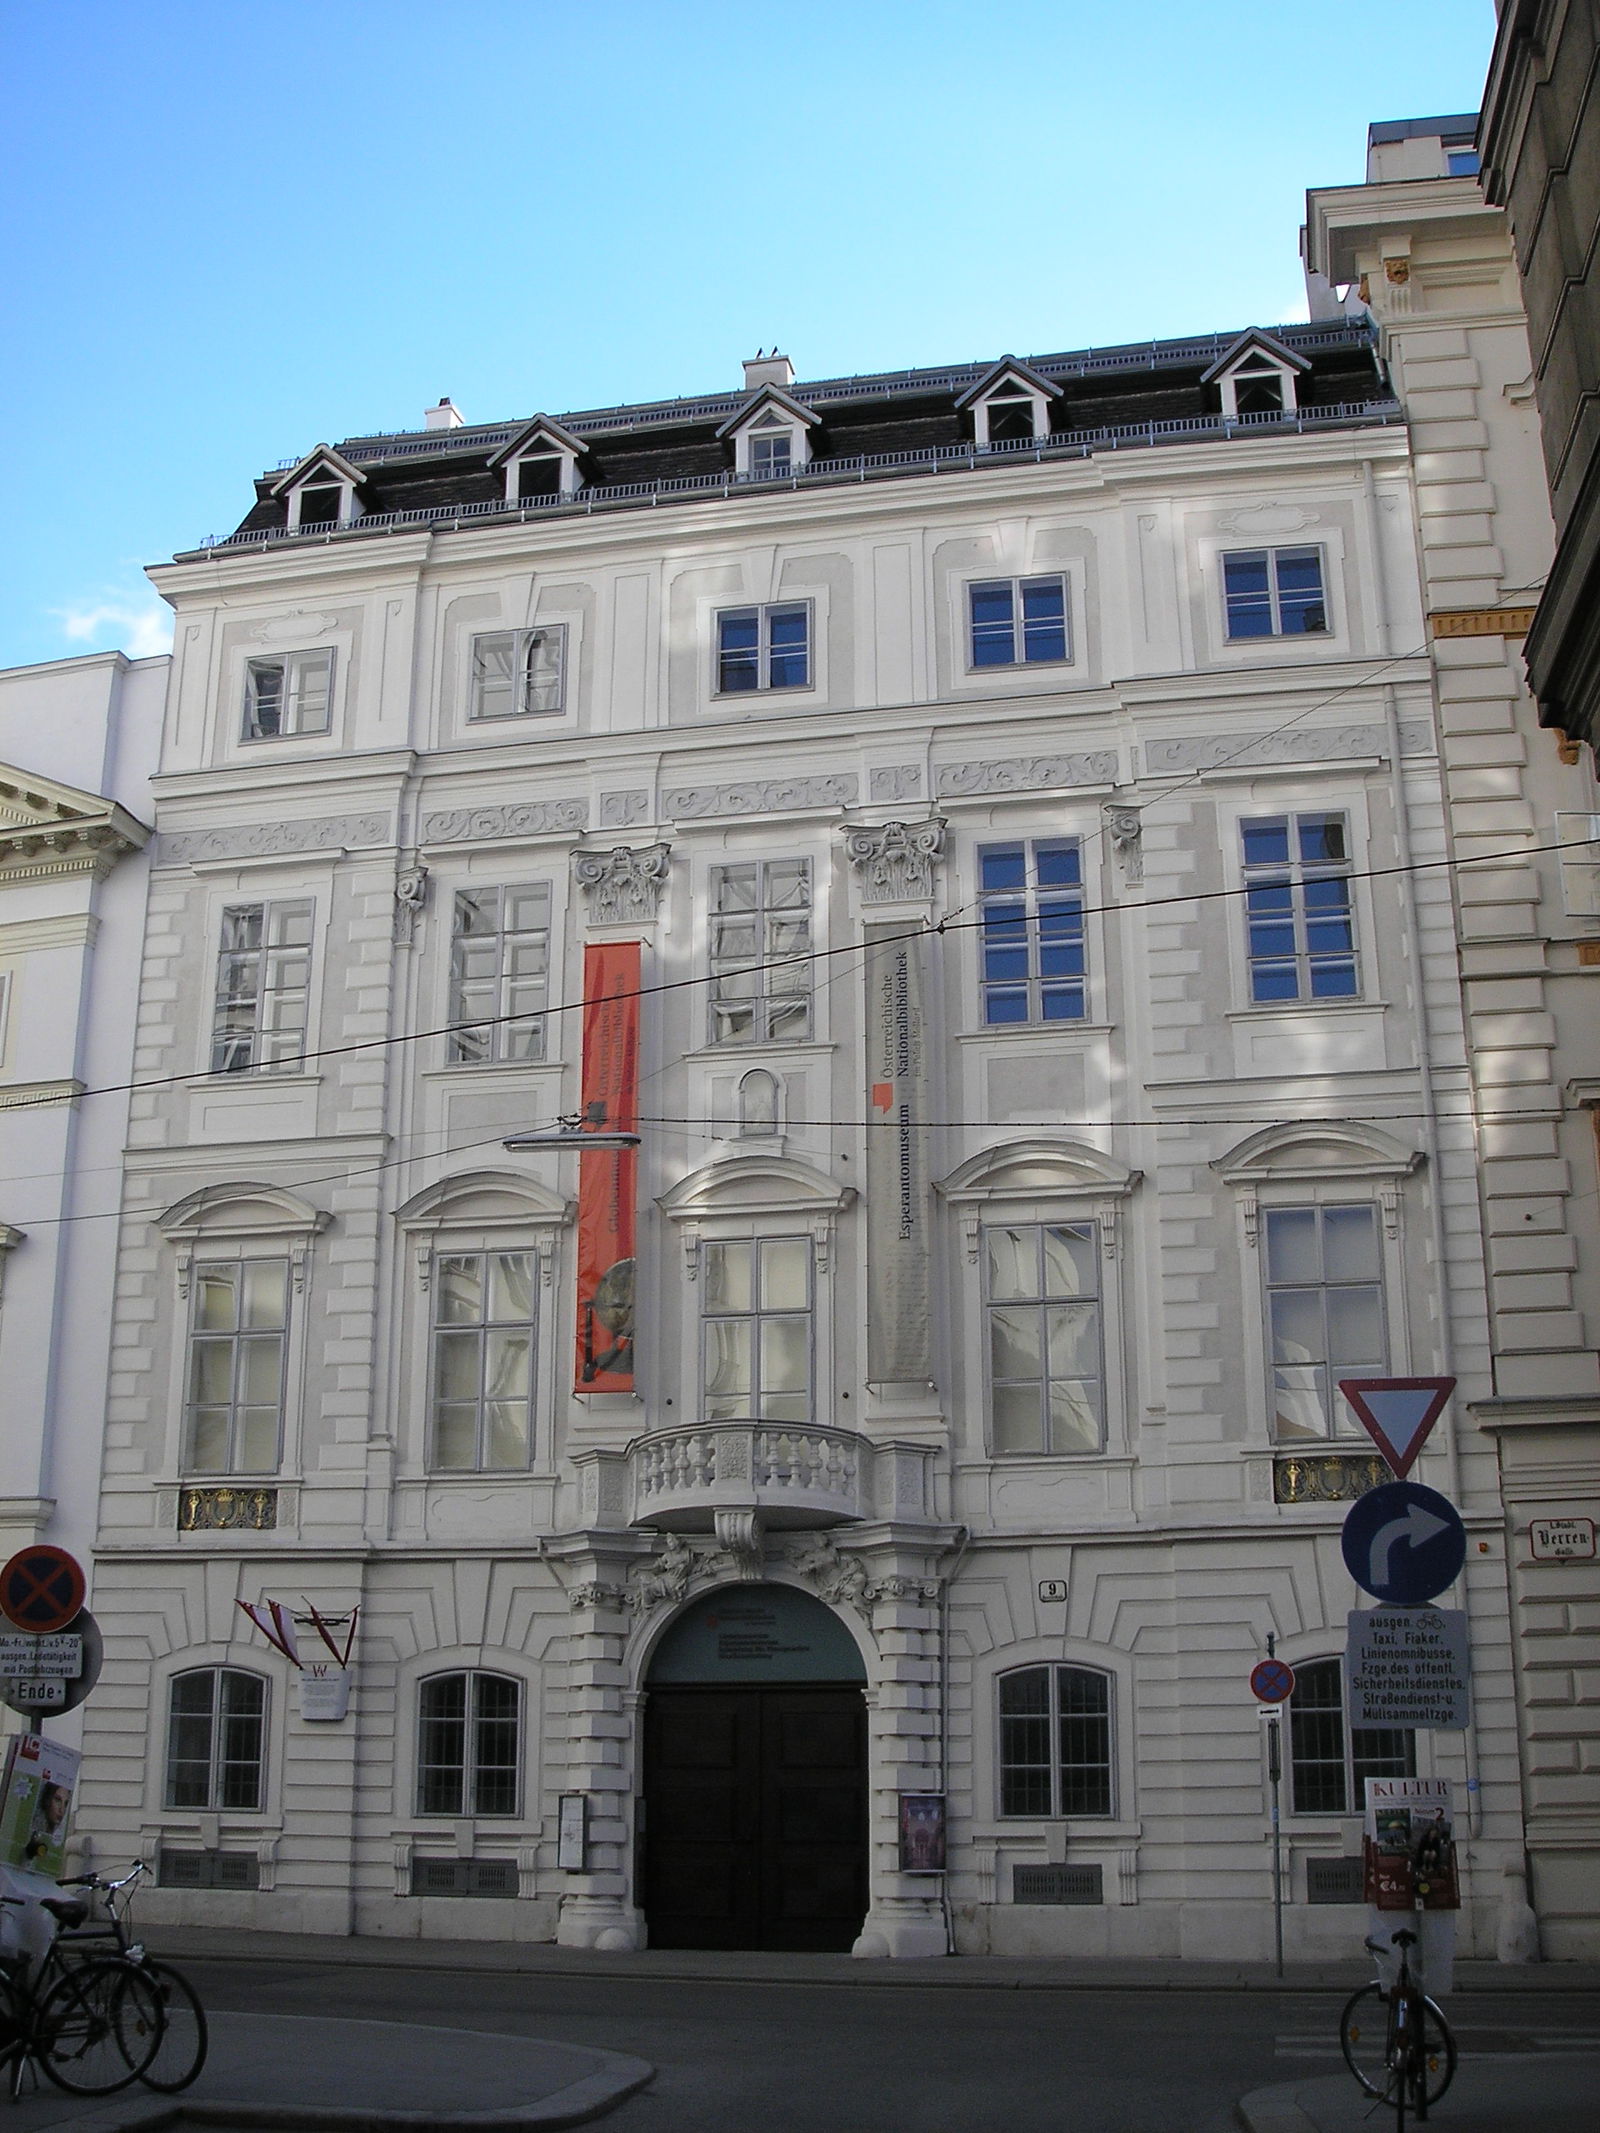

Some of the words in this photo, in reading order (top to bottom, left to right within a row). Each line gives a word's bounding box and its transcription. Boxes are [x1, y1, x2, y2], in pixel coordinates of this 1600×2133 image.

[880, 975, 894, 1079] Österreichische
[895, 951, 910, 1078] Nationalbibliothek
[608, 1119, 620, 1233] Globenmusm
[898, 1104, 913, 1241] Esperantomuseum
[1048, 1582, 1057, 1596] 9
[18, 1682, 55, 1699] Ende
[1373, 1780, 1448, 1797] KULTUR
